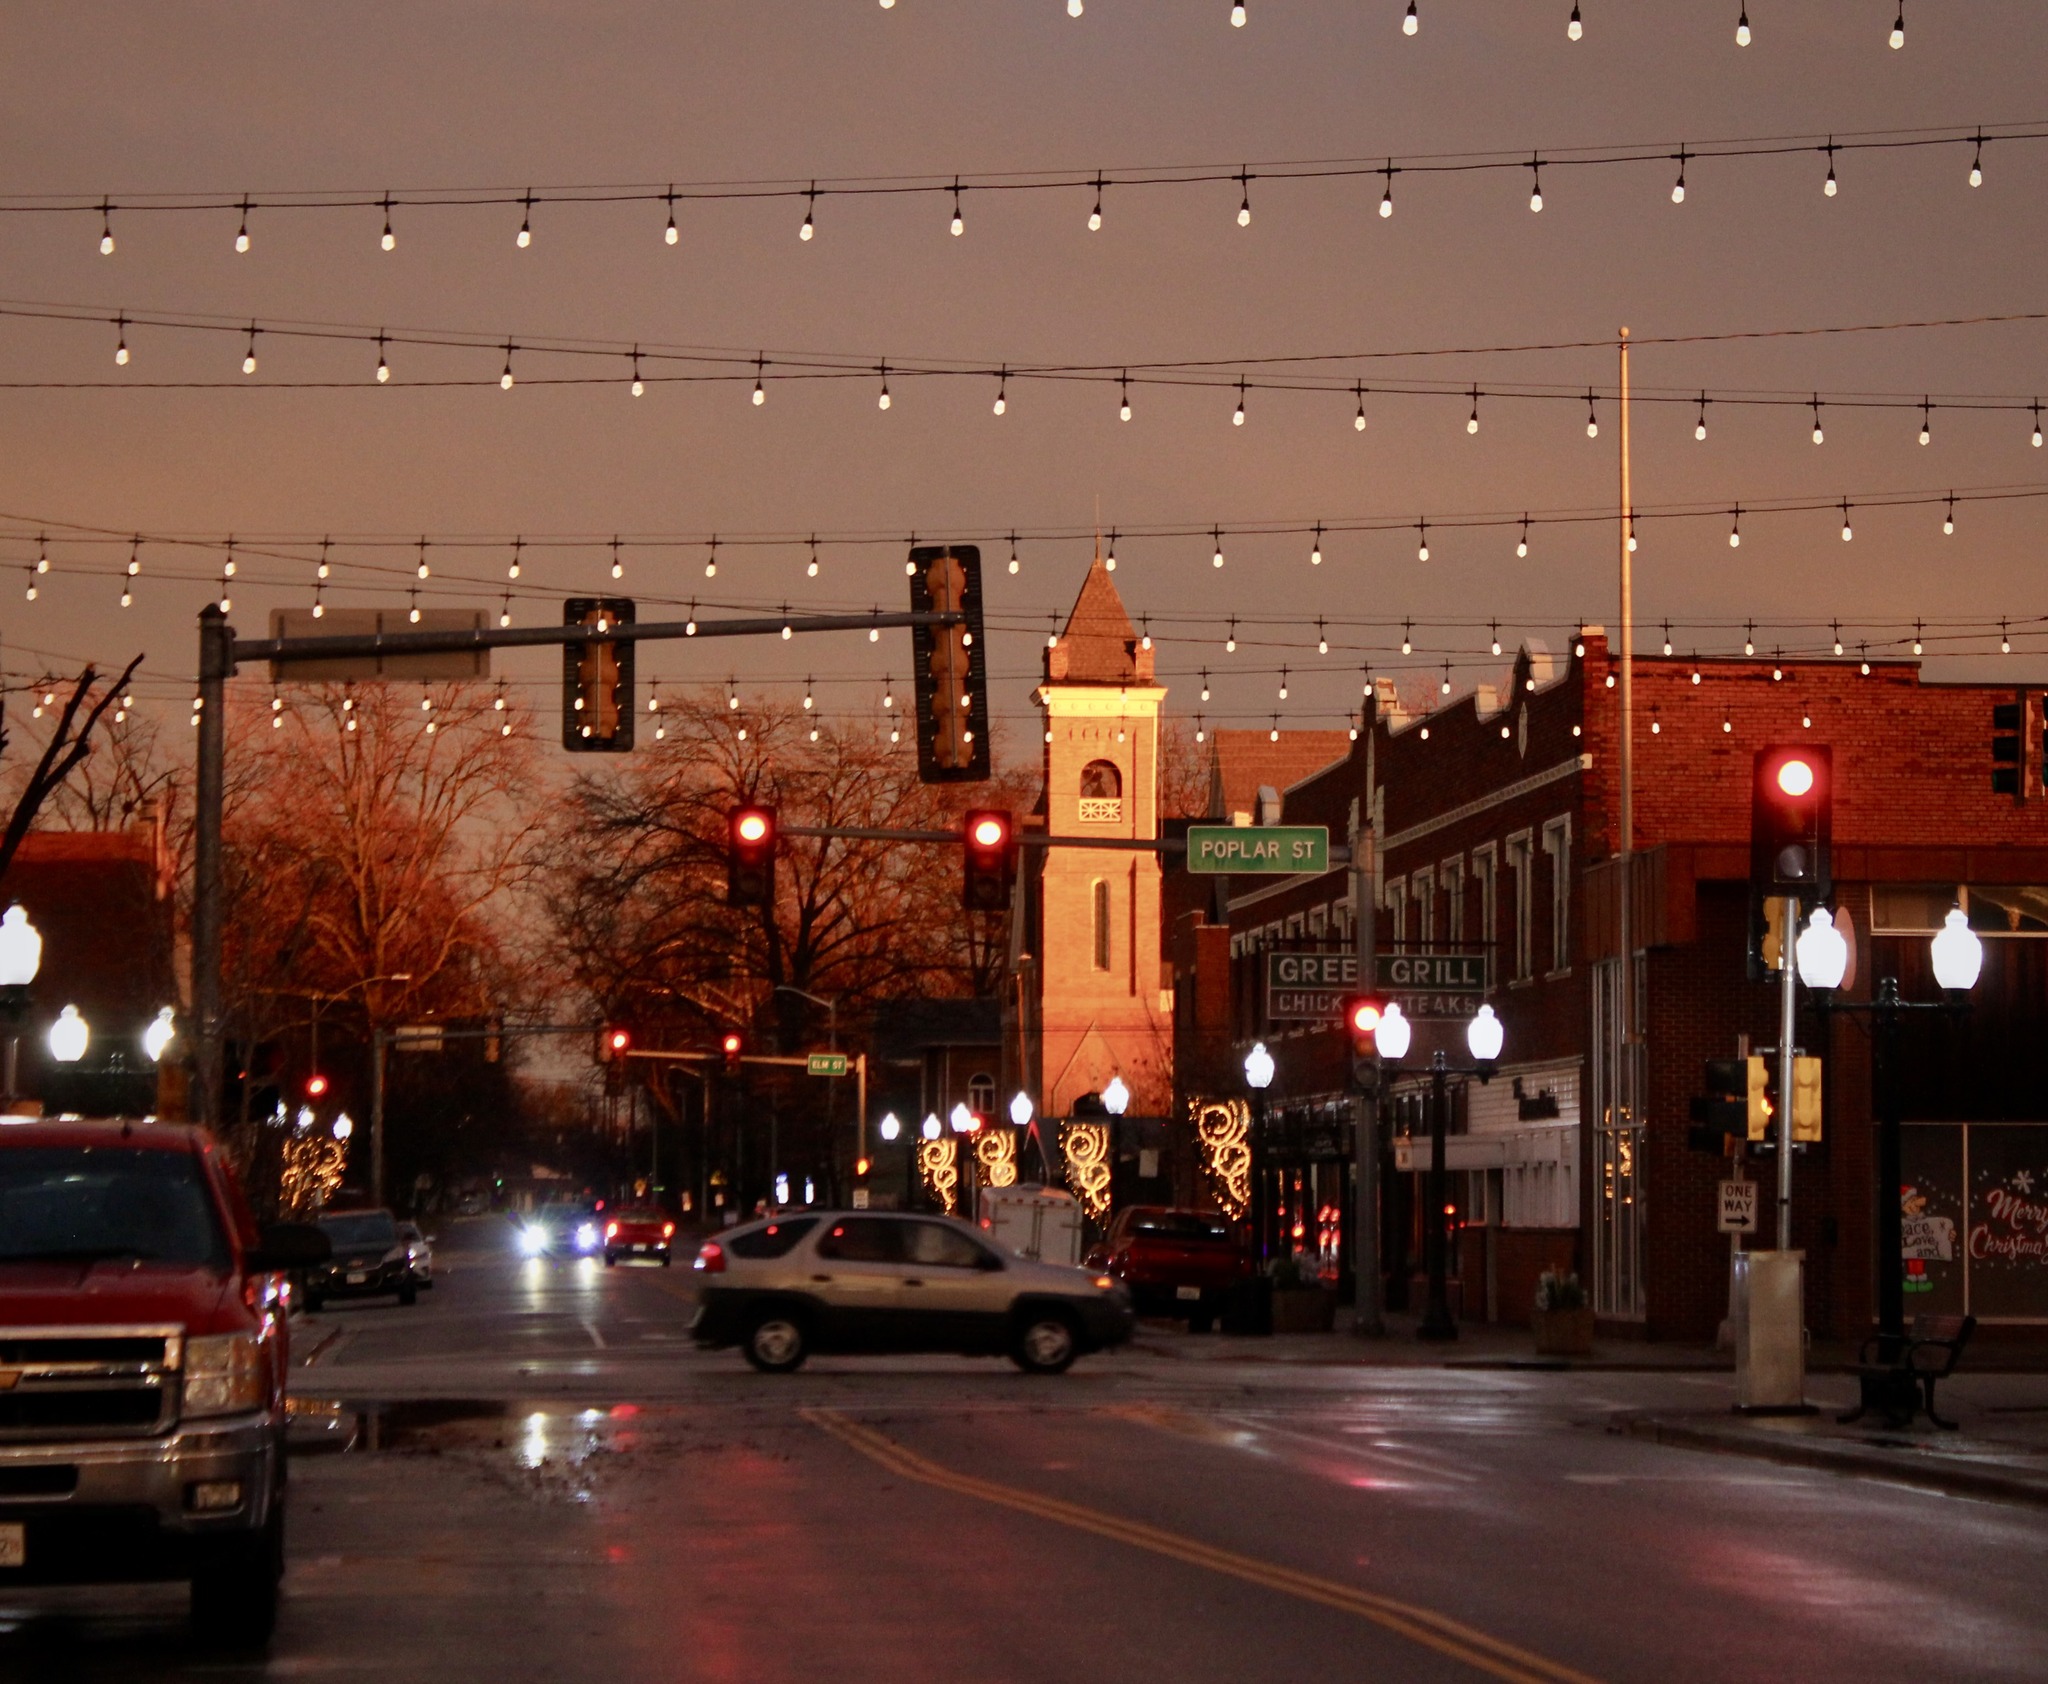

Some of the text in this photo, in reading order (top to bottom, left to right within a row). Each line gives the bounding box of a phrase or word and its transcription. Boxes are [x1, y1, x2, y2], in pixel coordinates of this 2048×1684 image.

[1201, 840, 1315, 859] POPLAR ST
[1279, 957, 1477, 984] GREE GRILL
[1279, 994, 1345, 1012] CHICK
[812, 1060, 843, 1070] ELM ST
[1726, 1185, 1752, 1198] ONE
[1724, 1200, 1752, 1212] WAY
